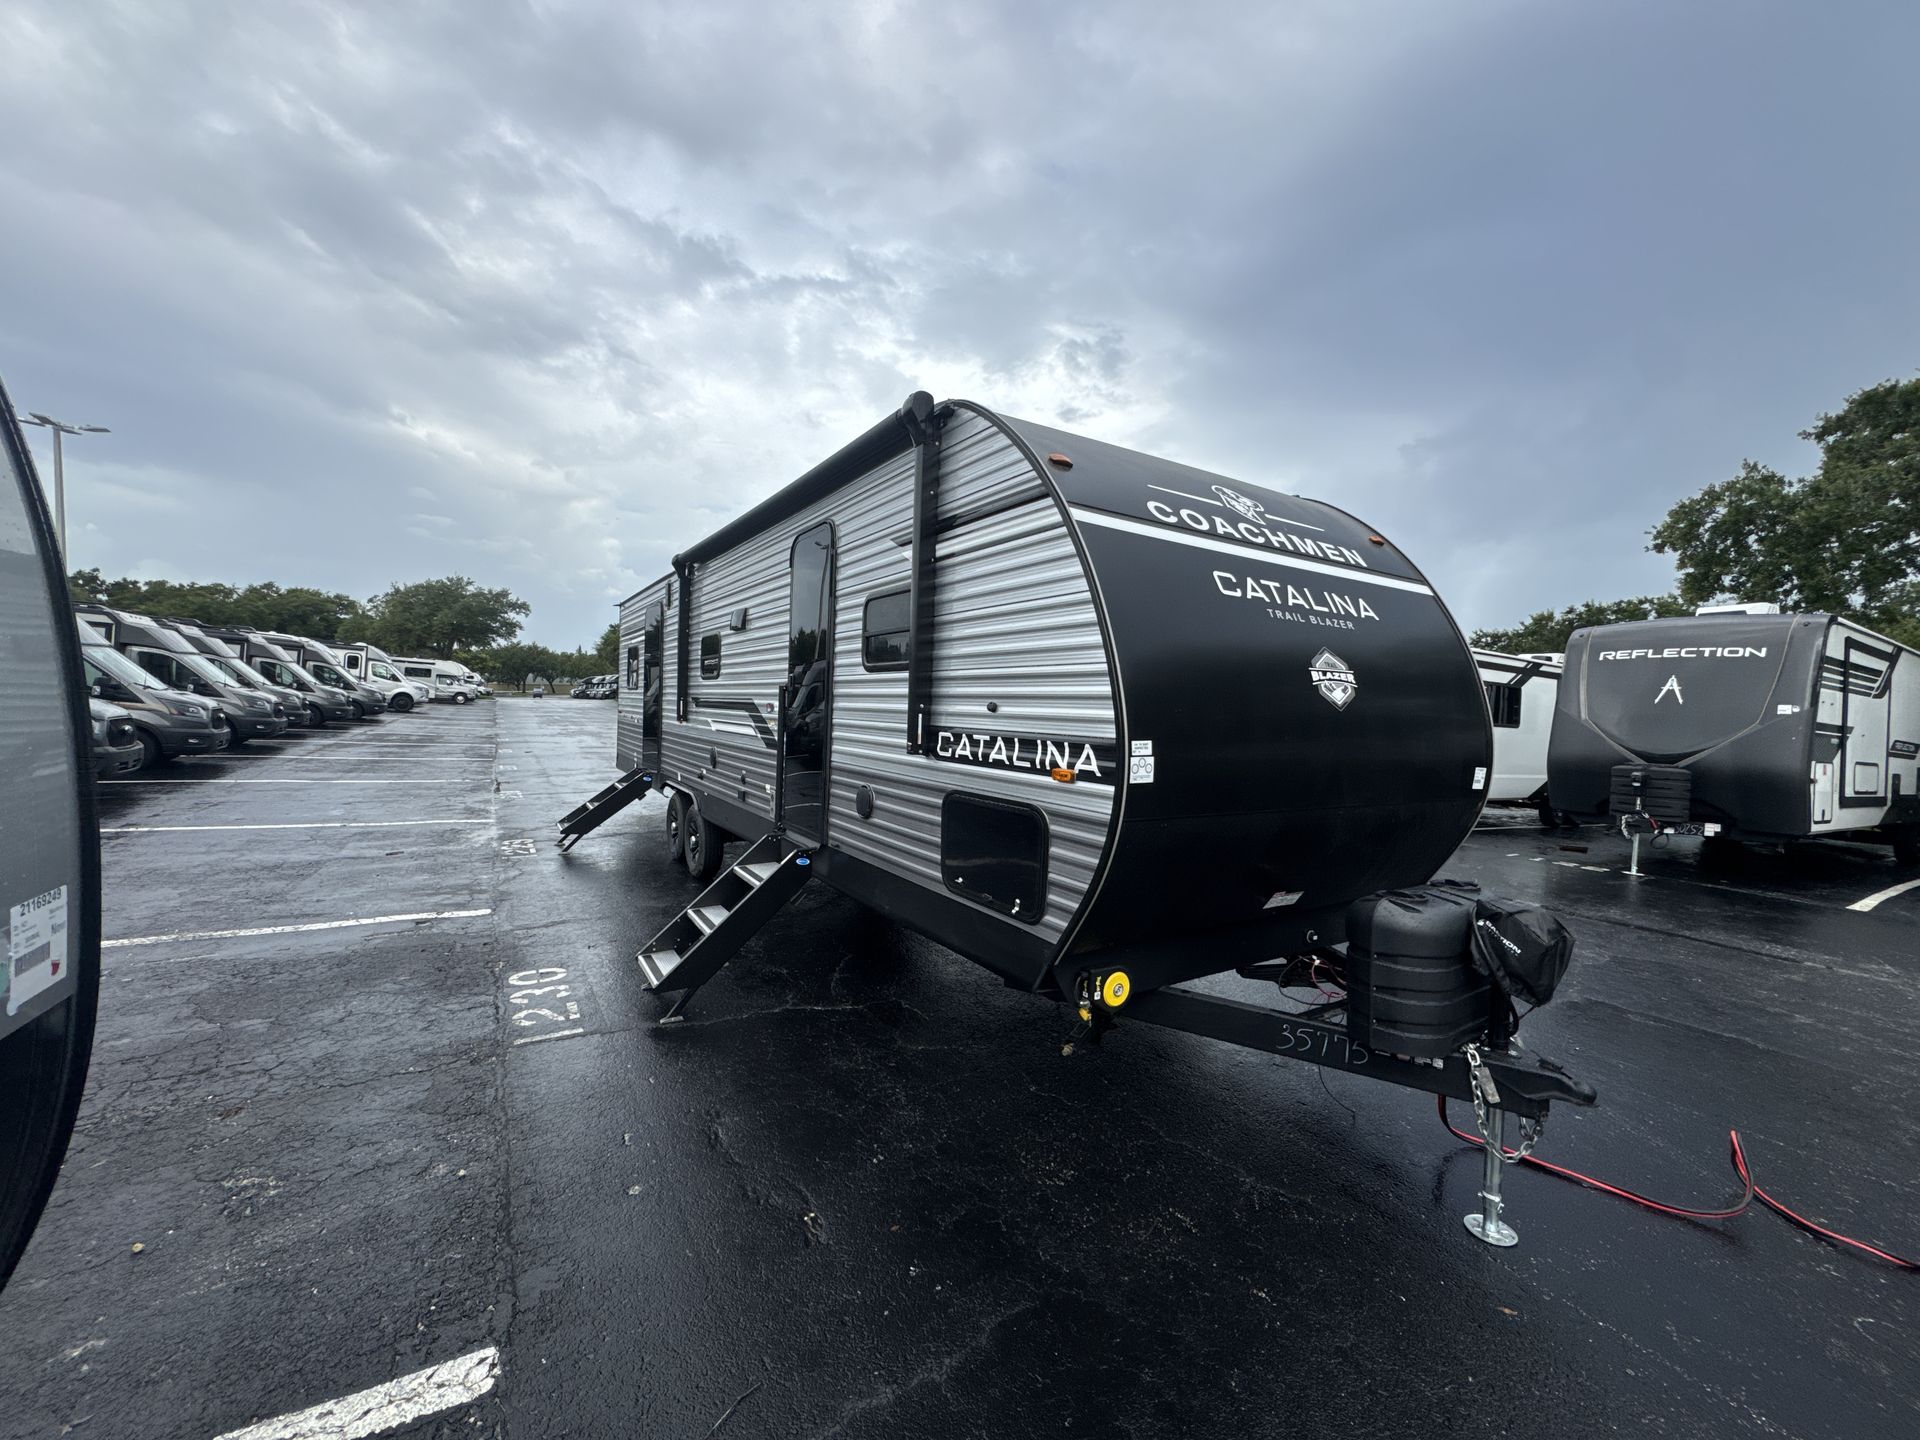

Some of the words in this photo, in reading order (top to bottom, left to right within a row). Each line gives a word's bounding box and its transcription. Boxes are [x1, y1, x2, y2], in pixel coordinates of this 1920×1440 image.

[1147, 500, 1368, 567] COACHMEN
[1213, 570, 1379, 621] CATALINA
[1267, 608, 1305, 623] TRAIL
[1310, 615, 1355, 630] BLAZER
[1324, 661, 1338, 669] TRAIL
[1599, 647, 1767, 661] REFLECTION
[1310, 670, 1356, 684] BLAZER
[937, 731, 1102, 777] CATALINA
[1276, 1023, 1369, 1065] 35775
